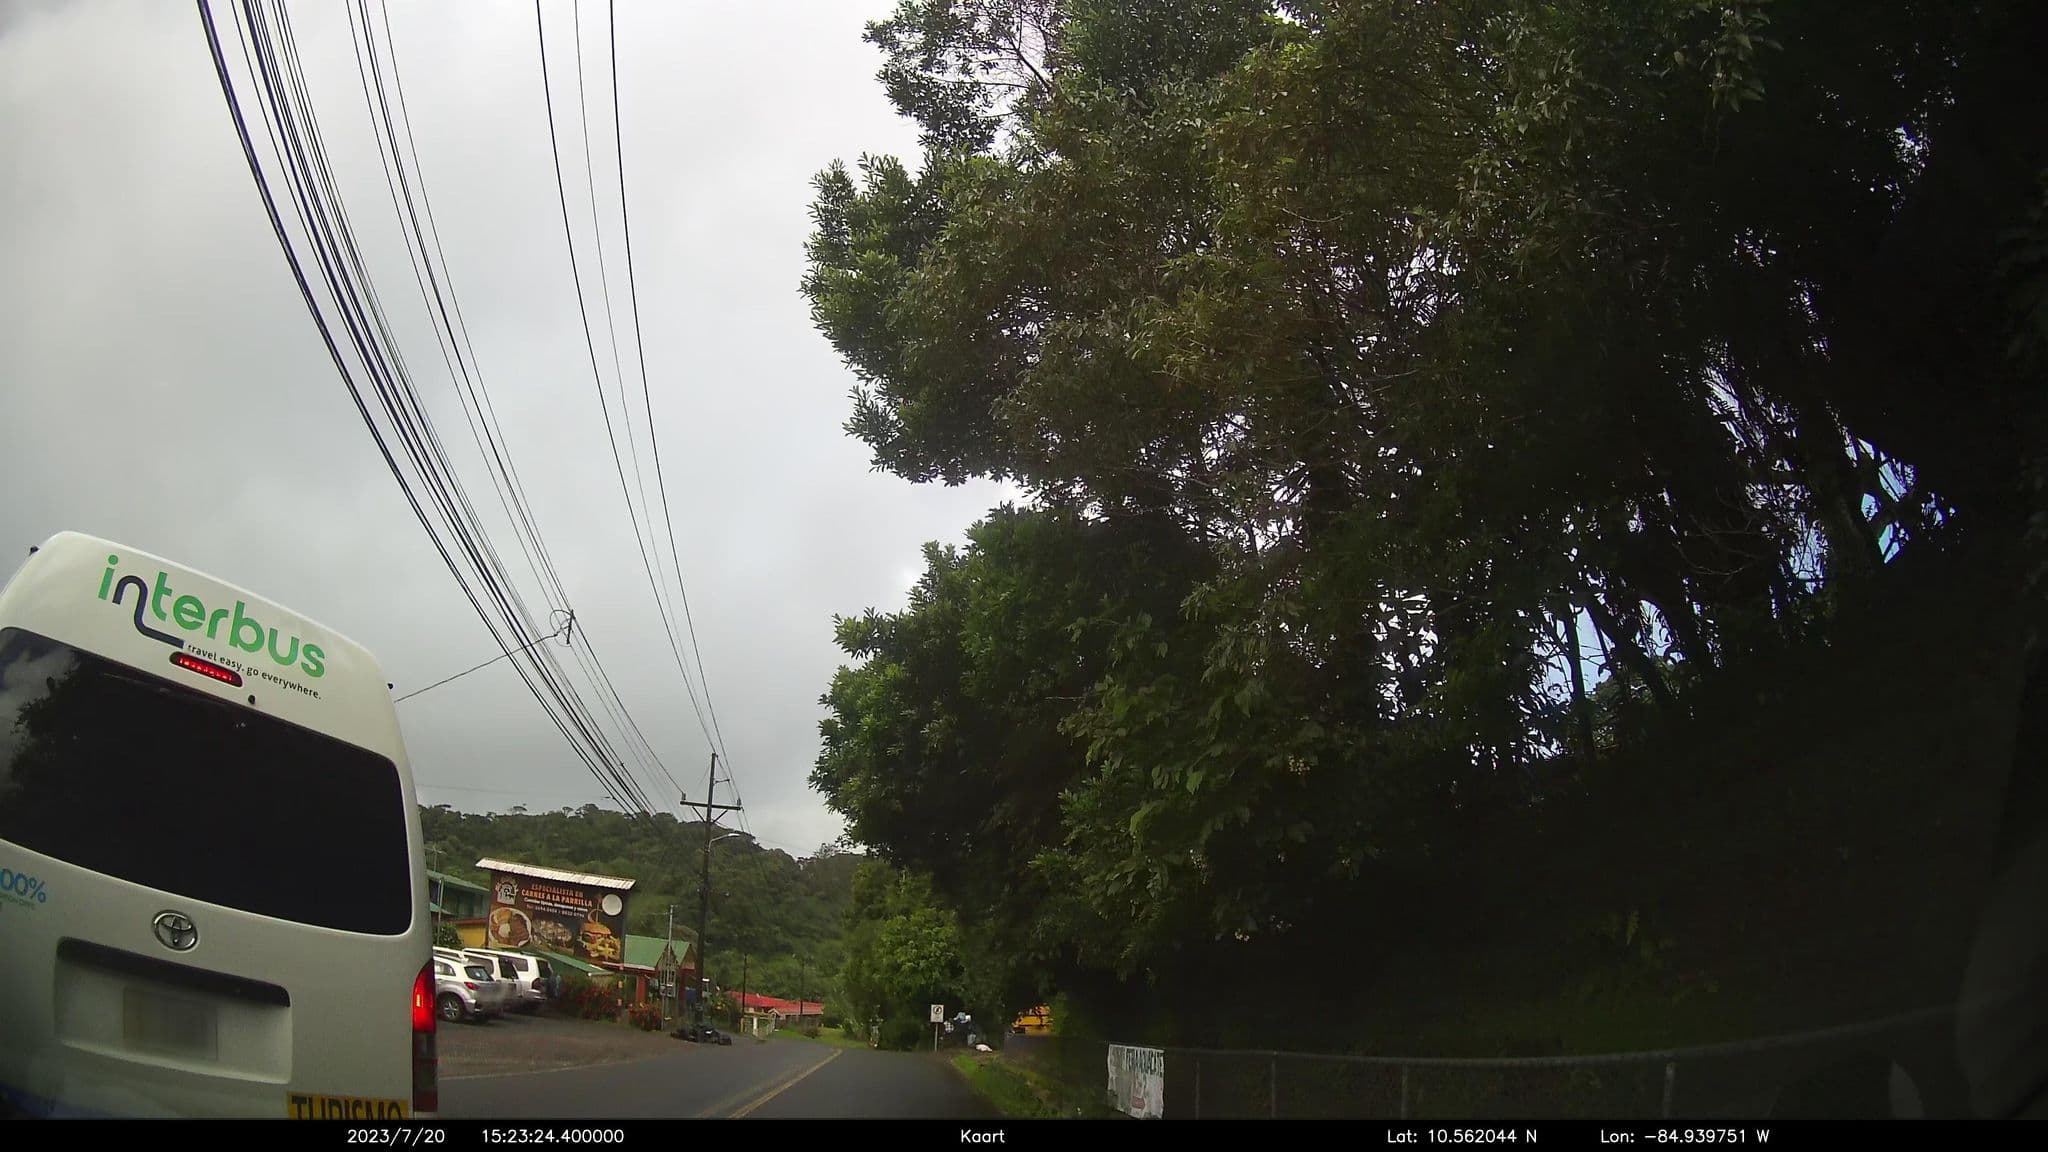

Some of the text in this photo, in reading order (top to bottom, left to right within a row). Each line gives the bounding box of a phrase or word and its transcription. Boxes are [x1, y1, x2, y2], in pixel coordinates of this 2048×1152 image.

[98, 554, 326, 678] interbus
[188, 643, 217, 662] travel
[246, 666, 259, 677] go
[261, 671, 322, 700] everywhere.
[521, 888, 545, 900] CARNES
[561, 895, 593, 908] PARRILLA
